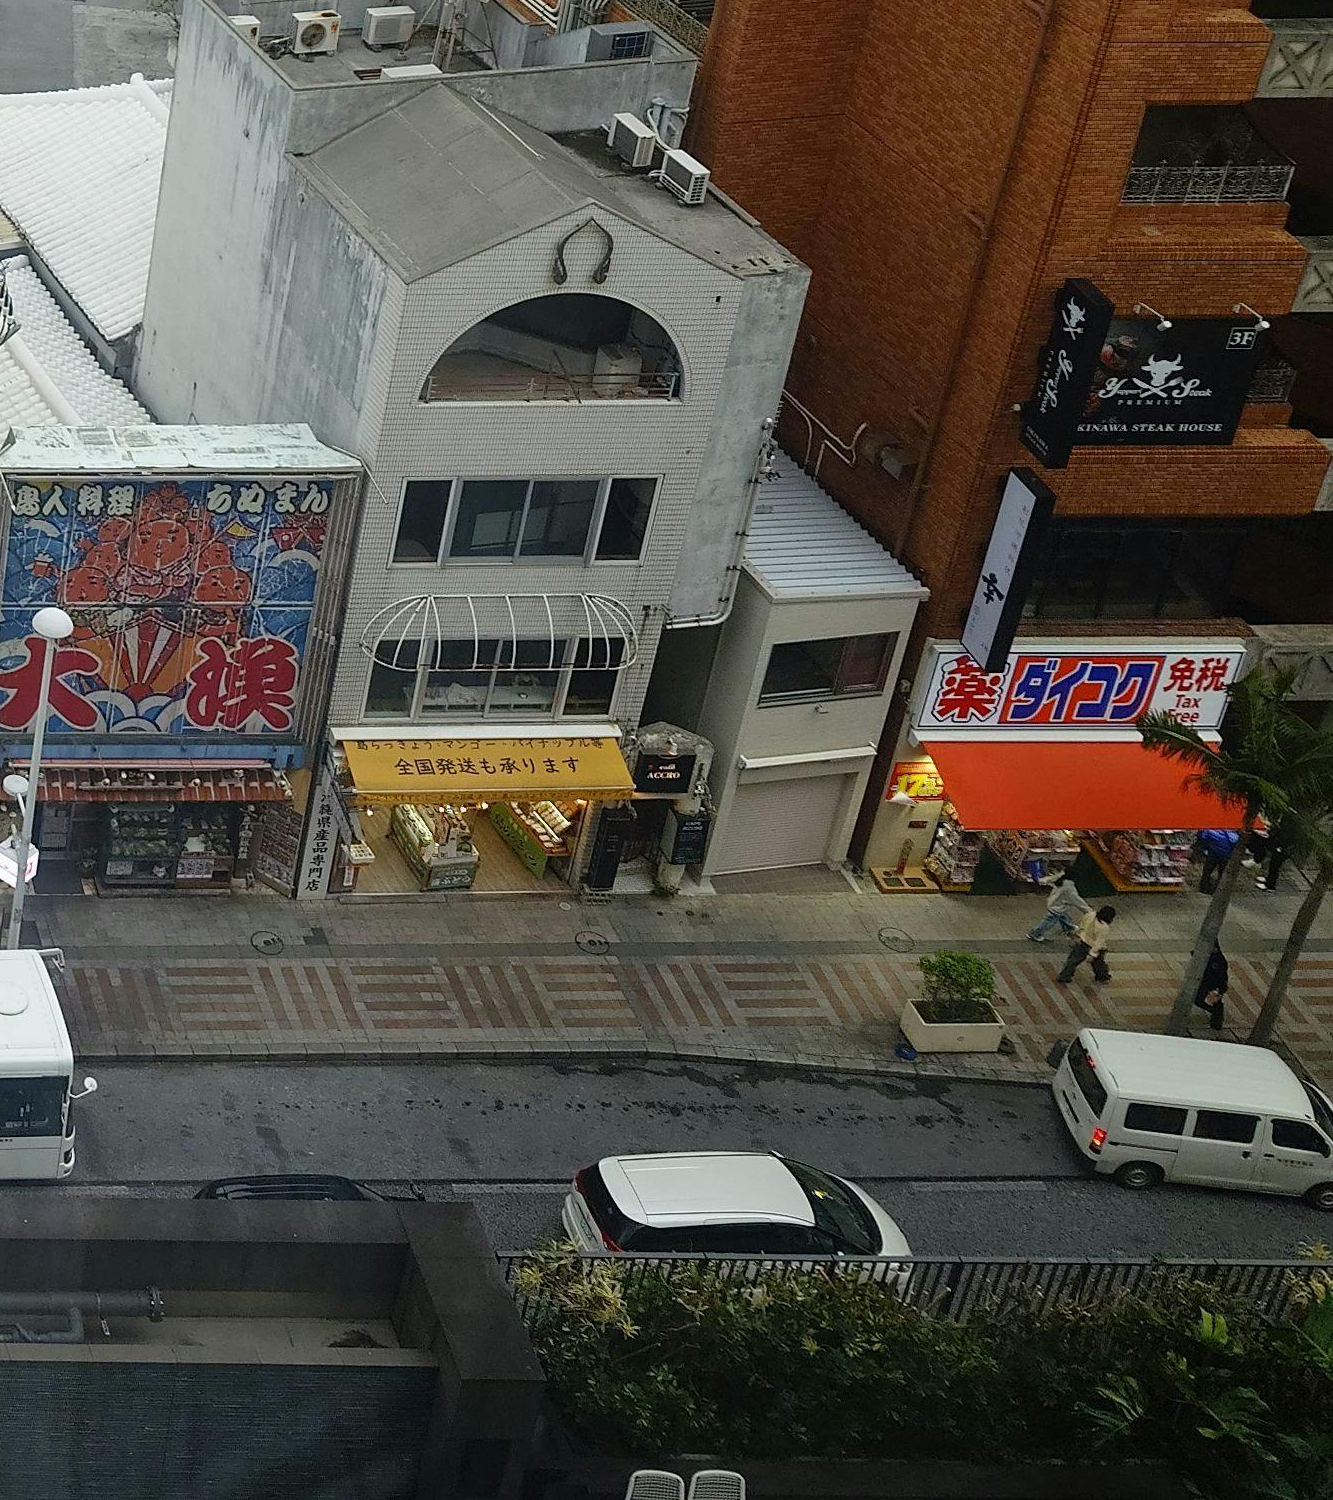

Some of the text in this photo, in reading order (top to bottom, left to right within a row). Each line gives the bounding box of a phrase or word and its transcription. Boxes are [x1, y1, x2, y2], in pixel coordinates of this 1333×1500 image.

[1229, 331, 1255, 346] 3F
[1077, 423, 1224, 433] KINAWA STEAK HOUSE
[13, 483, 135, 517] 島人料理
[207, 482, 329, 515] ちぬまん
[933, 655, 1231, 723] 薬 ダイコク 免税
[1174, 694, 1202, 708] Tax
[394, 756, 580, 776] 全国発送も承ります
